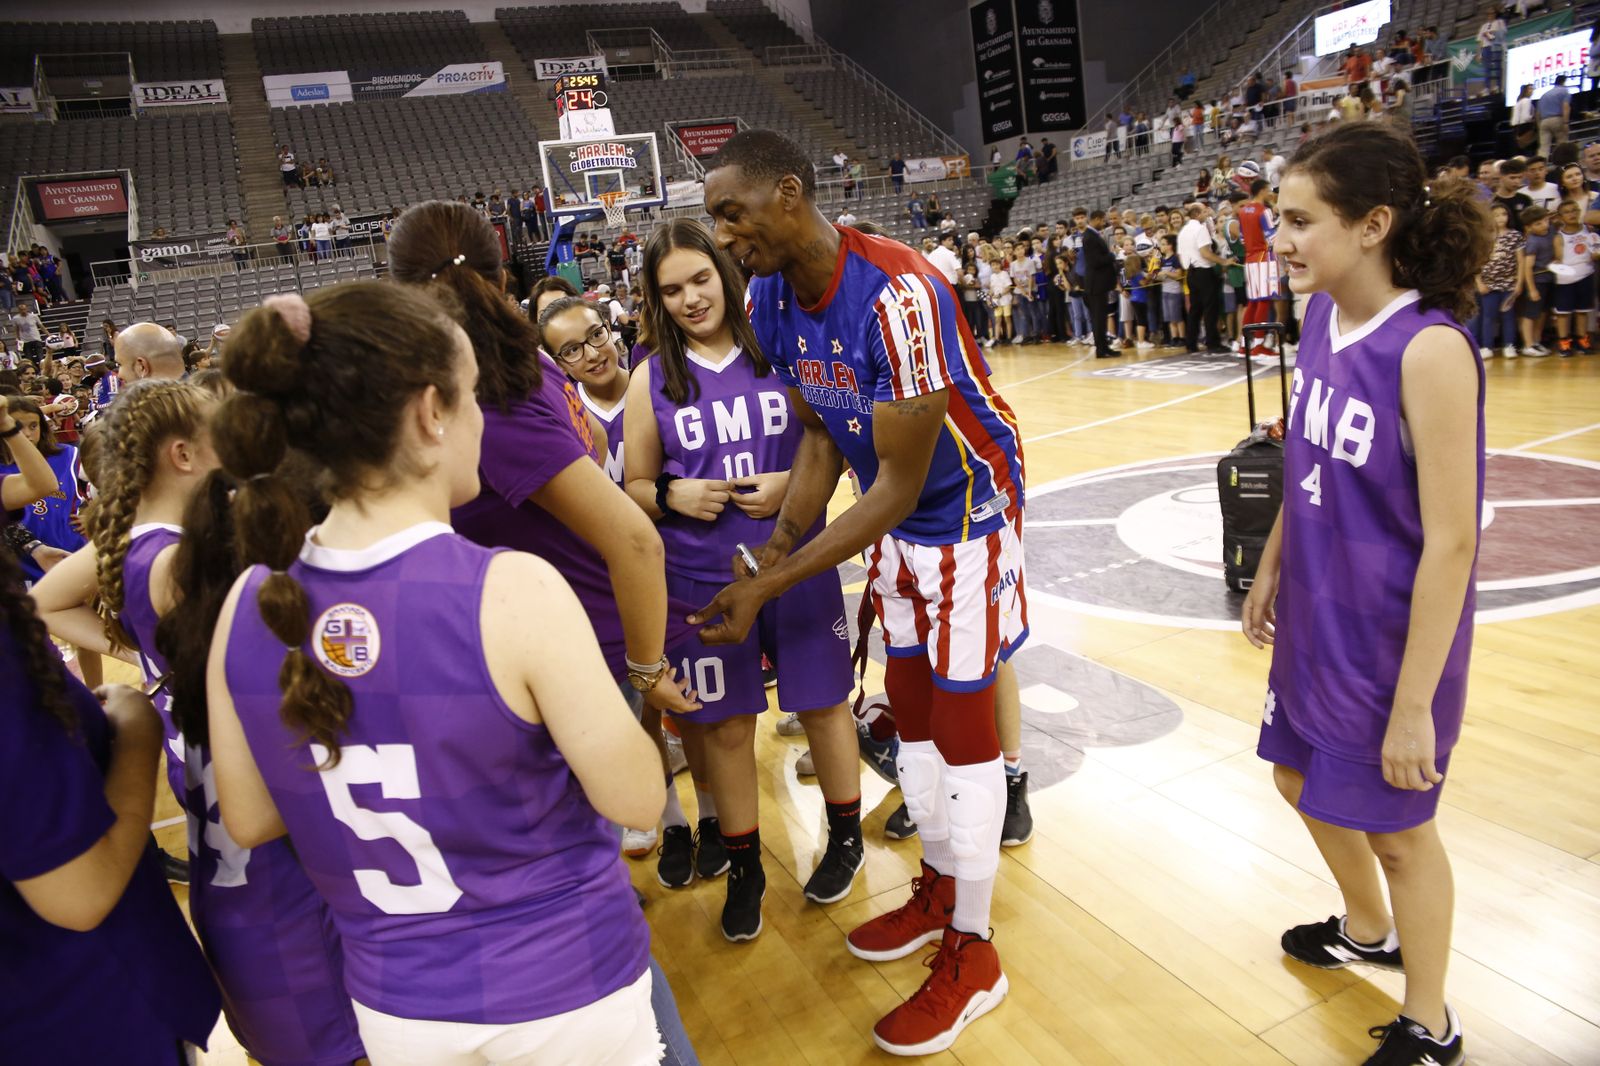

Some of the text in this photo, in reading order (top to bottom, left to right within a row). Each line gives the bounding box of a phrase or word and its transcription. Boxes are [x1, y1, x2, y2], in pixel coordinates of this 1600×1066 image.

[540, 60, 603, 74] IDEAL
[372, 74, 421, 85] BIENVENIDOS
[140, 83, 220, 101] IDEAL
[568, 91, 592, 110] 24
[683, 128, 733, 138] AYUNTAMIENTO
[578, 144, 625, 159] HARLEM
[571, 156, 637, 172] GLOBETROTTERS
[45, 183, 117, 196] AYUNTAMIENTO
[68, 193, 114, 205] GRANADA
[141, 244, 191, 263] gamo
[674, 391, 788, 451] GMB
[722, 451, 755, 483] 10
[1300, 463, 1322, 506] 4
[682, 656, 726, 702] 10
[309, 744, 463, 914] 5
